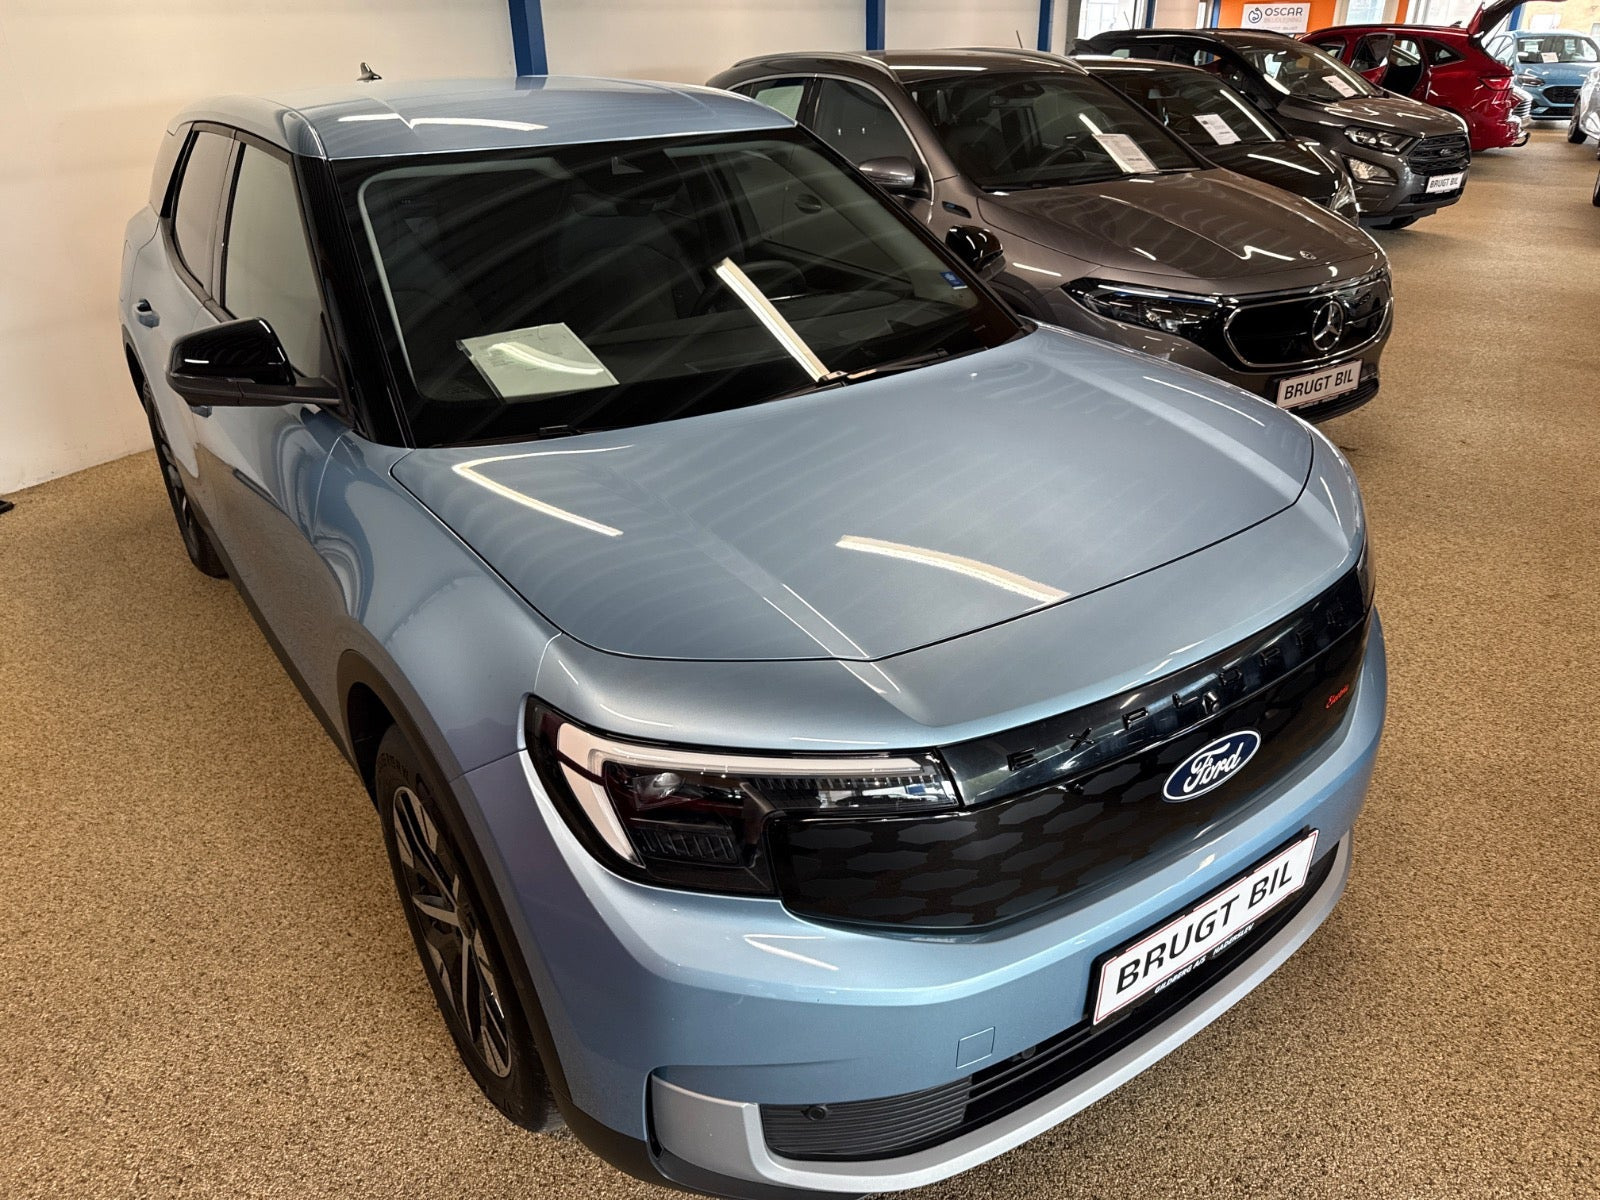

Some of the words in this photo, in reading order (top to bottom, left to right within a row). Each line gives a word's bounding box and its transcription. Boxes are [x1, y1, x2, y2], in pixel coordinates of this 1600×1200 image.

[1264, 7, 1303, 16] OSCAR
[1430, 178, 1450, 188] BRUGT
[1284, 374, 1333, 400] BRUGT
[1335, 369, 1353, 387] BIL
[1182, 741, 1241, 793] Ford
[1116, 894, 1240, 995] BRUGT
[1248, 860, 1292, 910] BIL
